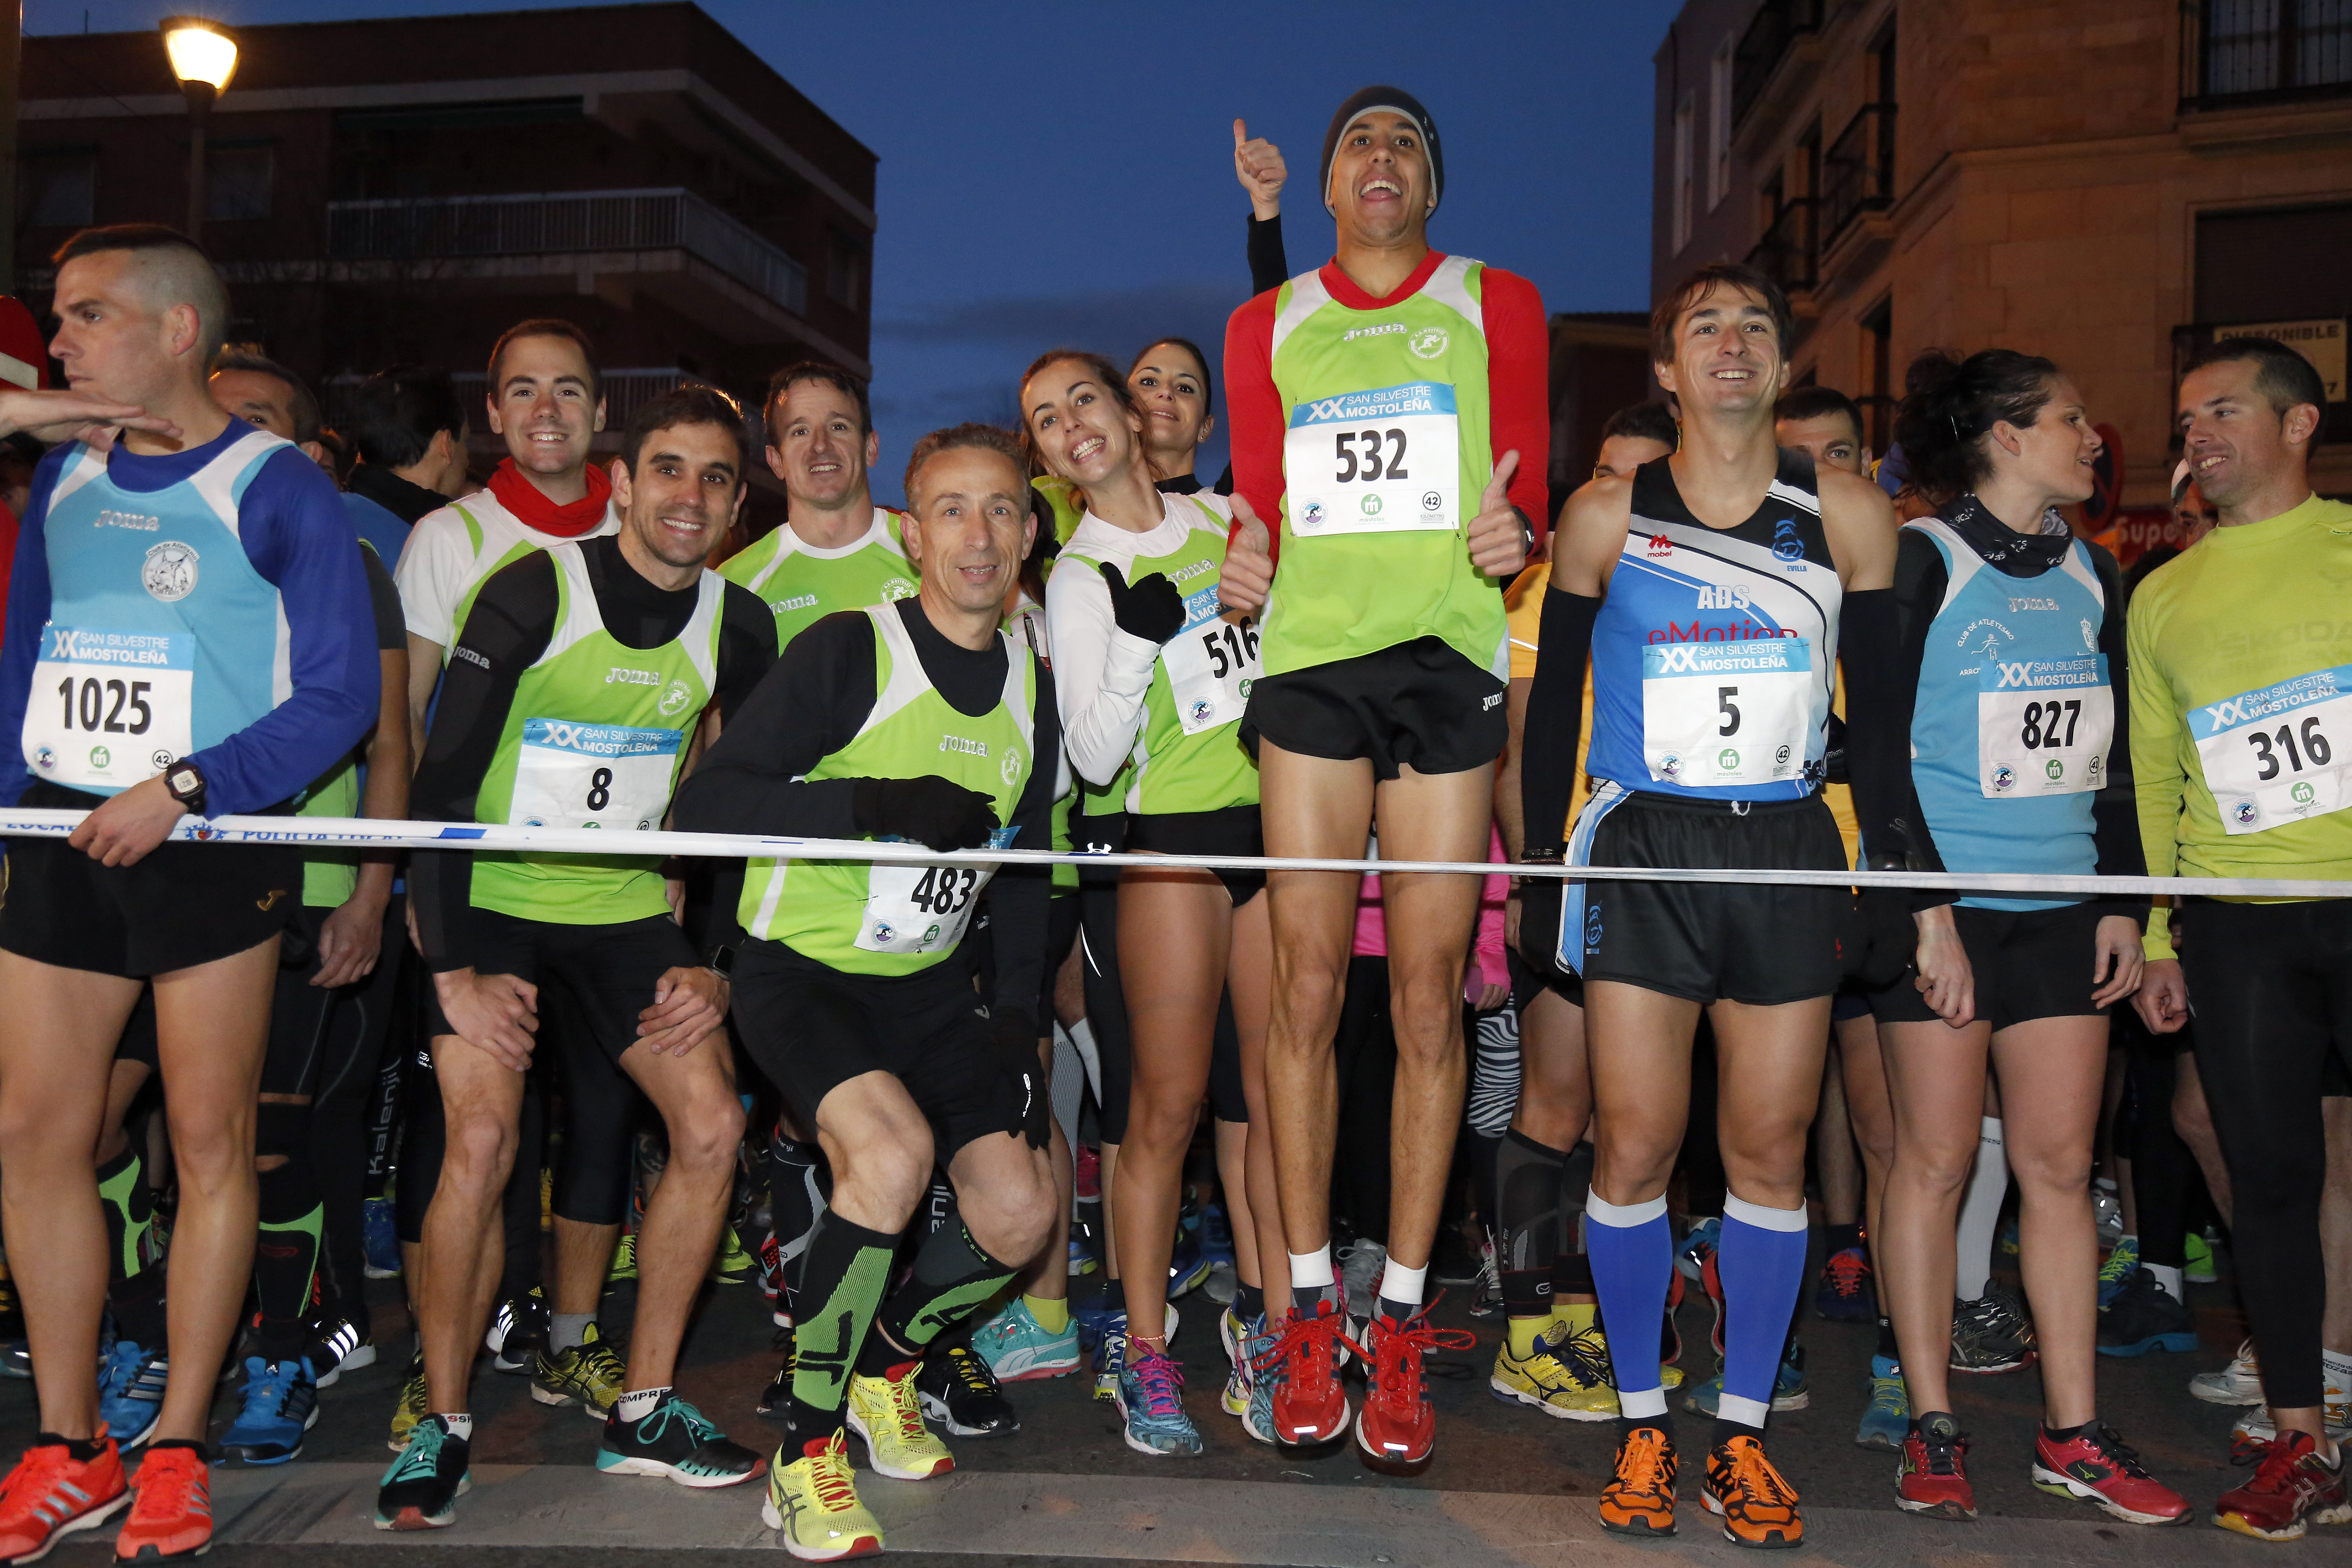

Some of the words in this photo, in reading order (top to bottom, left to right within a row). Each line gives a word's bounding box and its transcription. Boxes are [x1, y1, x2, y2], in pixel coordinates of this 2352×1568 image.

[1306, 397, 1346, 422] XX
[1347, 394, 1370, 405] SAN
[1373, 386, 1432, 402] SILVESTRE
[1346, 398, 1432, 418] MOSTOLEÑA
[1336, 428, 1408, 482] 532
[1425, 497, 1438, 505] 42
[172, 543, 197, 560] Atletismo
[1191, 593, 1210, 608] SAN
[1697, 585, 1750, 609] ADS
[51, 630, 80, 659] XX
[80, 632, 104, 644] SAN
[107, 635, 169, 649] SILVESTRE
[1202, 616, 1259, 678] 516
[1957, 631, 1969, 647] CLUB
[1968, 622, 1977, 632] DE
[1979, 619, 2014, 640] ATLETISMO
[79, 647, 168, 664] MOSTOLEÑA
[1659, 646, 1701, 674] XX
[1699, 646, 1724, 657] SAN
[1726, 643, 1787, 655] SILVESTRE
[1699, 655, 1788, 671] MOSTOLEÑA
[1997, 662, 2034, 688] XX
[2034, 662, 2054, 673] SAN
[2056, 659, 2097, 671] SILVESTRE
[2033, 671, 2098, 686] MOSTOLEÑA
[59, 677, 152, 736] 1025
[1718, 686, 1740, 736] 5
[2205, 697, 2251, 732] XX
[2245, 691, 2270, 705] SAN
[2271, 672, 2335, 697] SILVESTRE
[2248, 685, 2340, 719] MOSTOLEÑA
[2021, 699, 2081, 750] 827
[156, 755, 170, 764] 42
[1778, 749, 1788, 759] 42
[2248, 716, 2331, 781] 316
[587, 767, 613, 811] 8
[911, 866, 977, 915] 483
